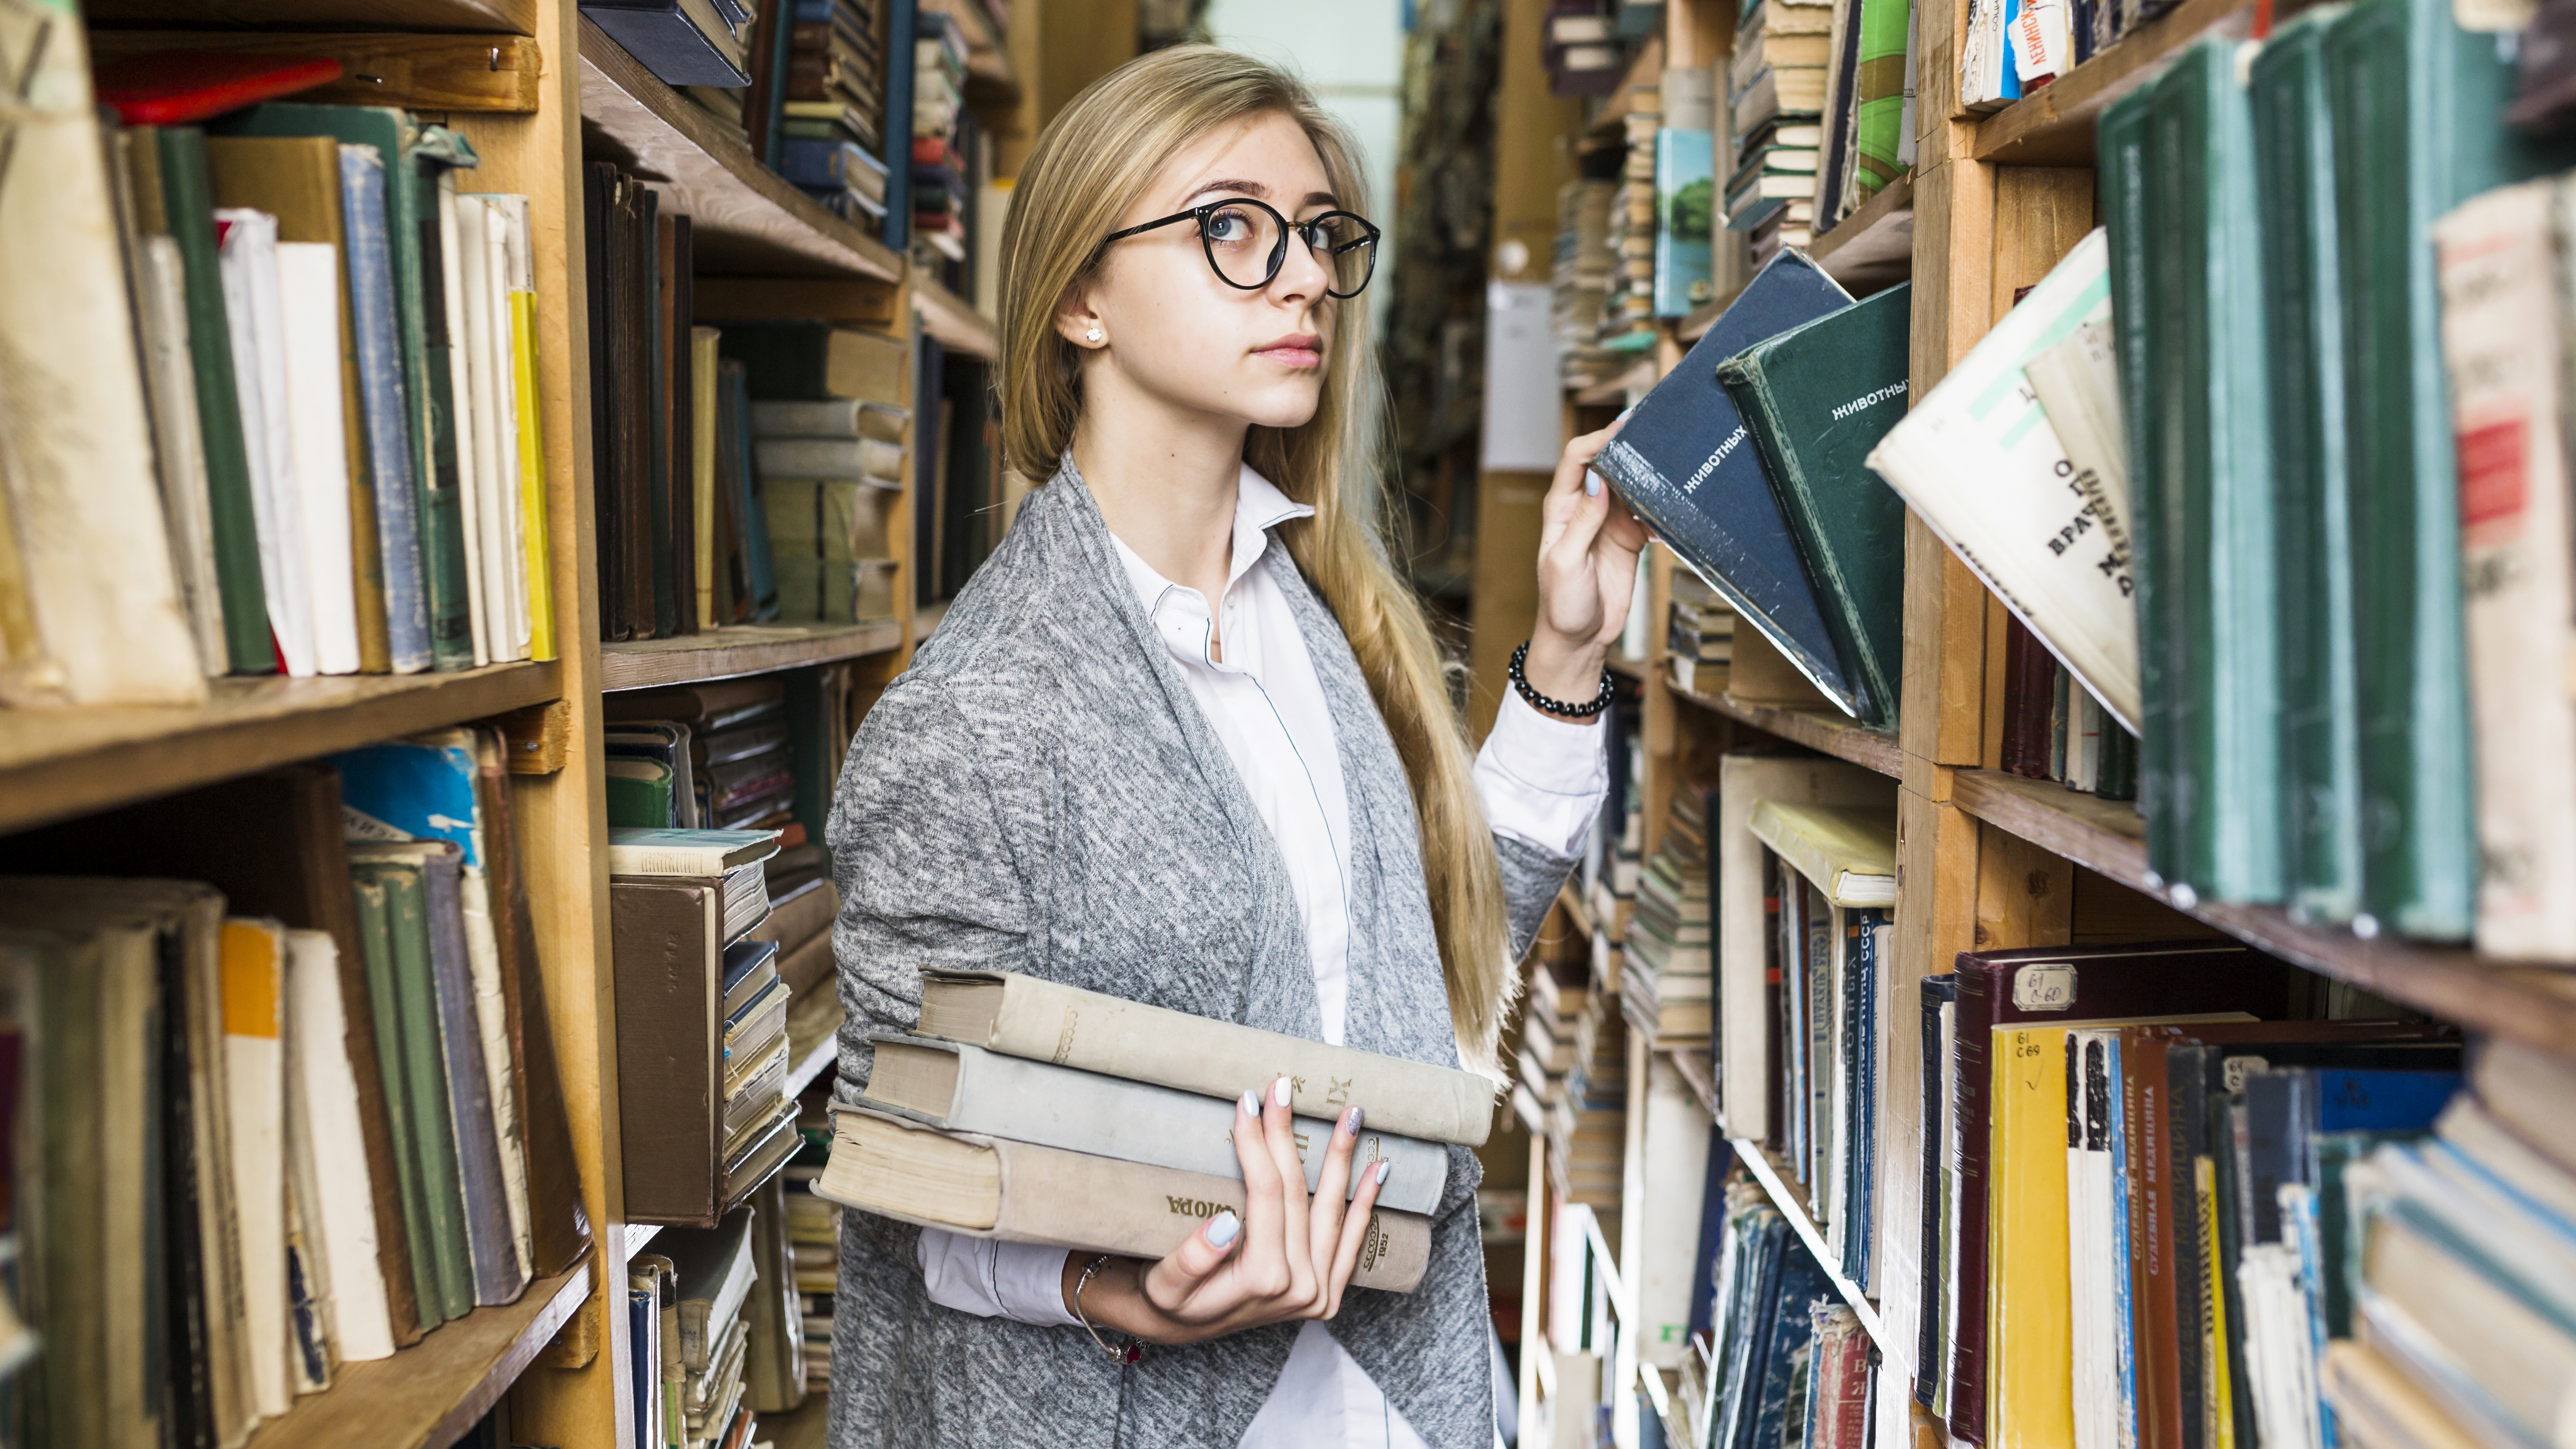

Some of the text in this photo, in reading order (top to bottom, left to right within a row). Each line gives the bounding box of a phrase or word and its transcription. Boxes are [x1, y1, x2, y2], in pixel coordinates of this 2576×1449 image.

[1683, 424, 1747, 495] ЖИВОТНЫХ
[1860, 914, 1870, 961] СССР
[2125, 1076, 2138, 1170] МЕДИЦИНА
[2143, 1086, 2159, 1276] СУДЕБНАЯ МЕДИЦИНА
[2169, 1086, 2191, 1246] МЕДИЦИНА
[1377, 1233, 1389, 1257] 1952
